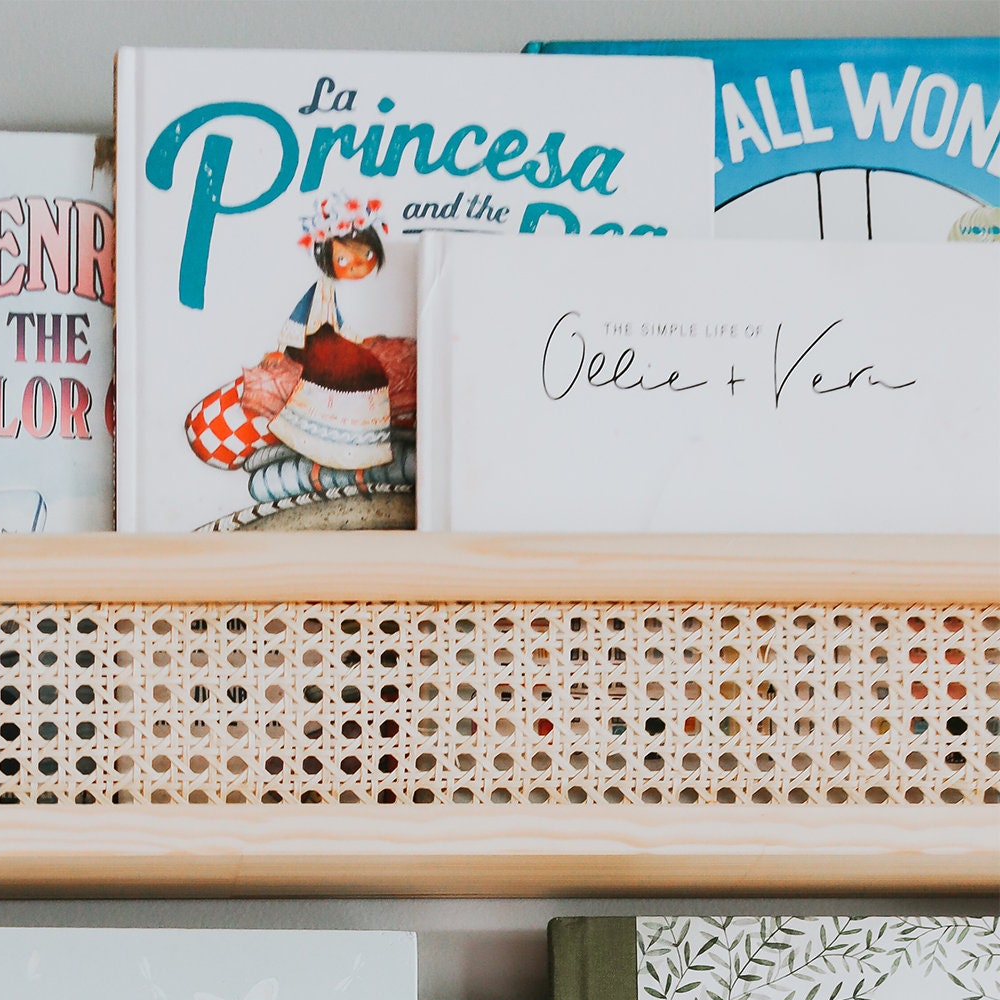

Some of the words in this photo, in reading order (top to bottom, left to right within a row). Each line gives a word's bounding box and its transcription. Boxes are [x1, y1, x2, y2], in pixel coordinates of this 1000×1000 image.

[299, 76, 358, 115] La
[721, 81, 834, 164] ALL
[839, 61, 1000, 178] WON
[145, 96, 625, 310] Princesa
[402, 191, 464, 221] and
[466, 194, 511, 224] the
[7, 312, 91, 365] THE
[542, 311, 708, 400] Ollie
[604, 322, 632, 336] THE
[640, 322, 697, 337] SIMPLE
[705, 323, 737, 337] LIFE
[745, 323, 763, 337] OF
